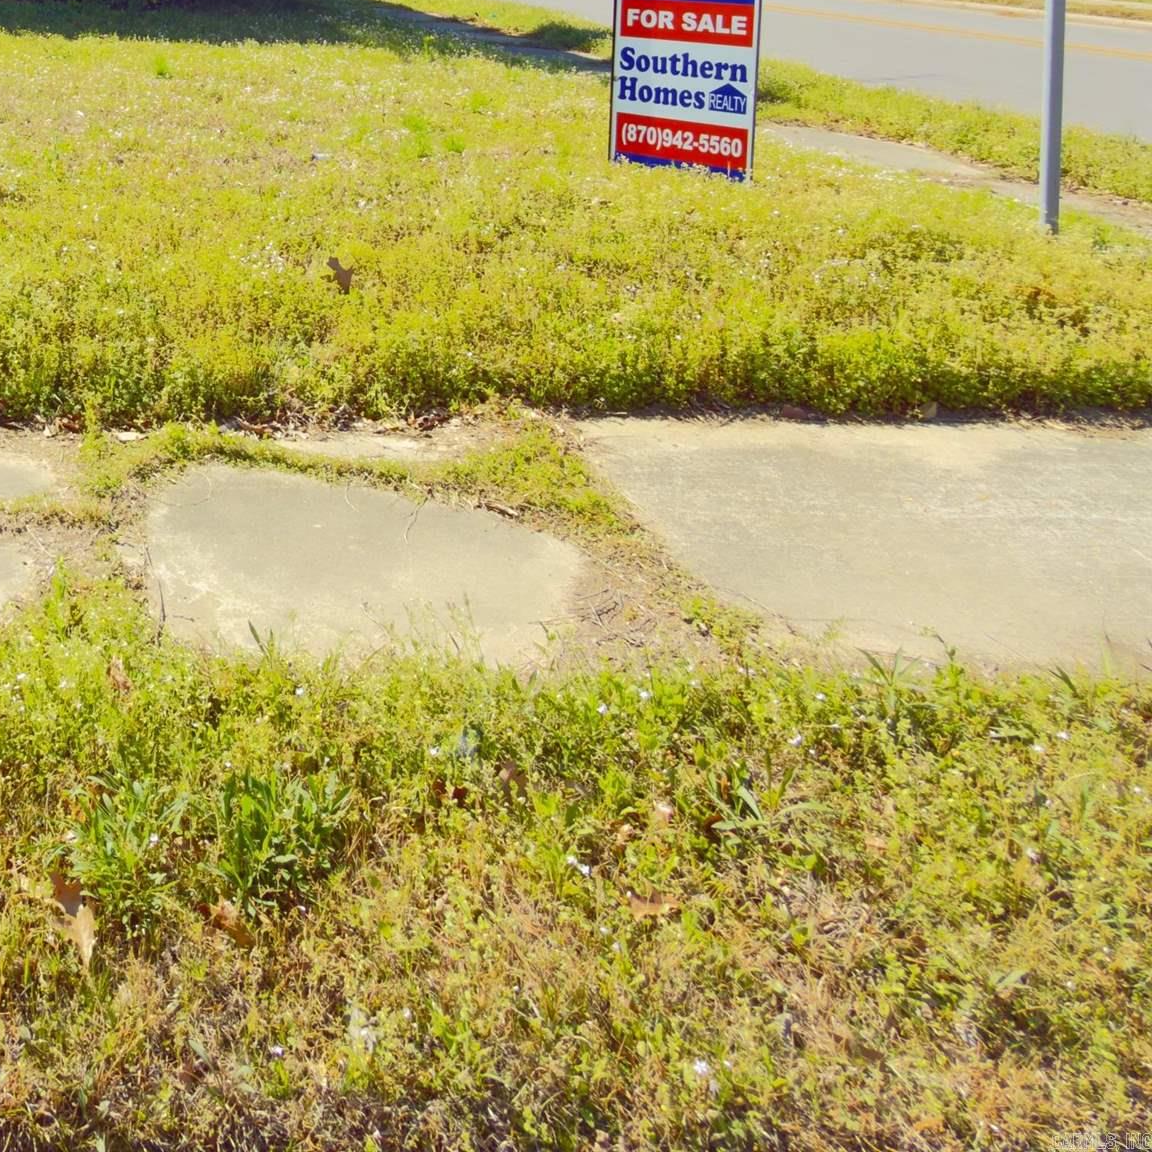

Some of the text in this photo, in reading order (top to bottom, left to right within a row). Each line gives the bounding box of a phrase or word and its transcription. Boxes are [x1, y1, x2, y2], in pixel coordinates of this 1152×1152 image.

[626, 8, 747, 36] FOR SALE
[619, 46, 748, 83] Southern
[617, 75, 746, 113] Homes REALTY
[621, 122, 742, 158] (870)942-5560
